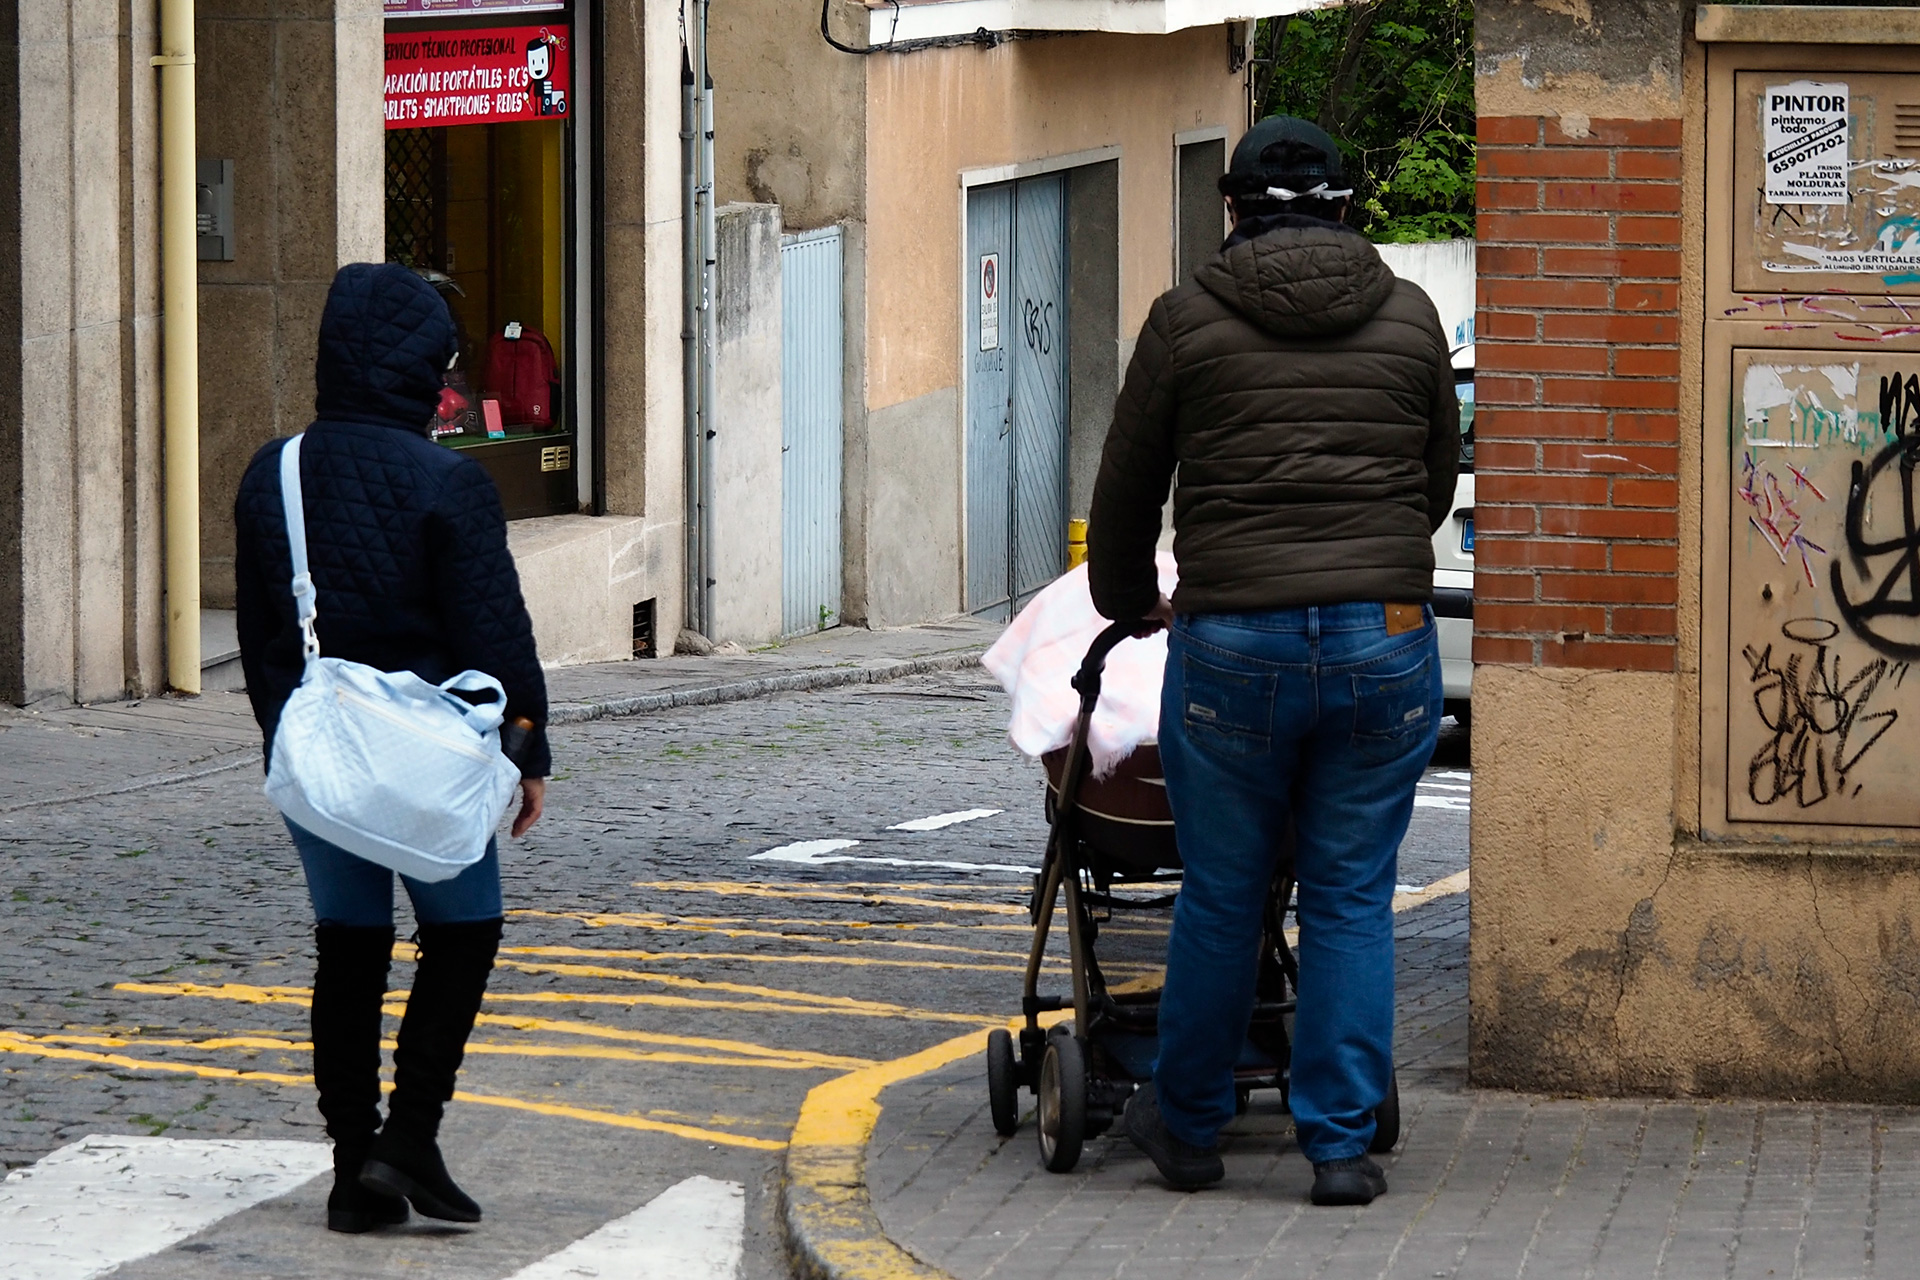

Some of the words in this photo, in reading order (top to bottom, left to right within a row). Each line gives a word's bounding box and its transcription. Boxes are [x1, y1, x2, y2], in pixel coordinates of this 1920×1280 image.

[422, 36, 458, 59] TÉCNICO
[460, 37, 516, 57] PROFESIONAL
[384, 67, 428, 95] ARACIÓN
[430, 71, 441, 92] DE
[443, 64, 502, 92] PORTÁTILES
[508, 66, 529, 87] PC'S
[384, 97, 418, 121] ABLETS
[423, 94, 490, 118] SMARTPHONES
[496, 92, 523, 113] REDES
[1771, 95, 1845, 112] PINTOR
[1771, 114, 1826, 126] pintamos
[1780, 123, 1808, 134] todo
[1771, 136, 1811, 158] ACUCHILLAR
[1810, 121, 1840, 141] PARQUET
[1772, 134, 1846, 174] 659077202
[1787, 180, 1846, 188] MOLDURAS
